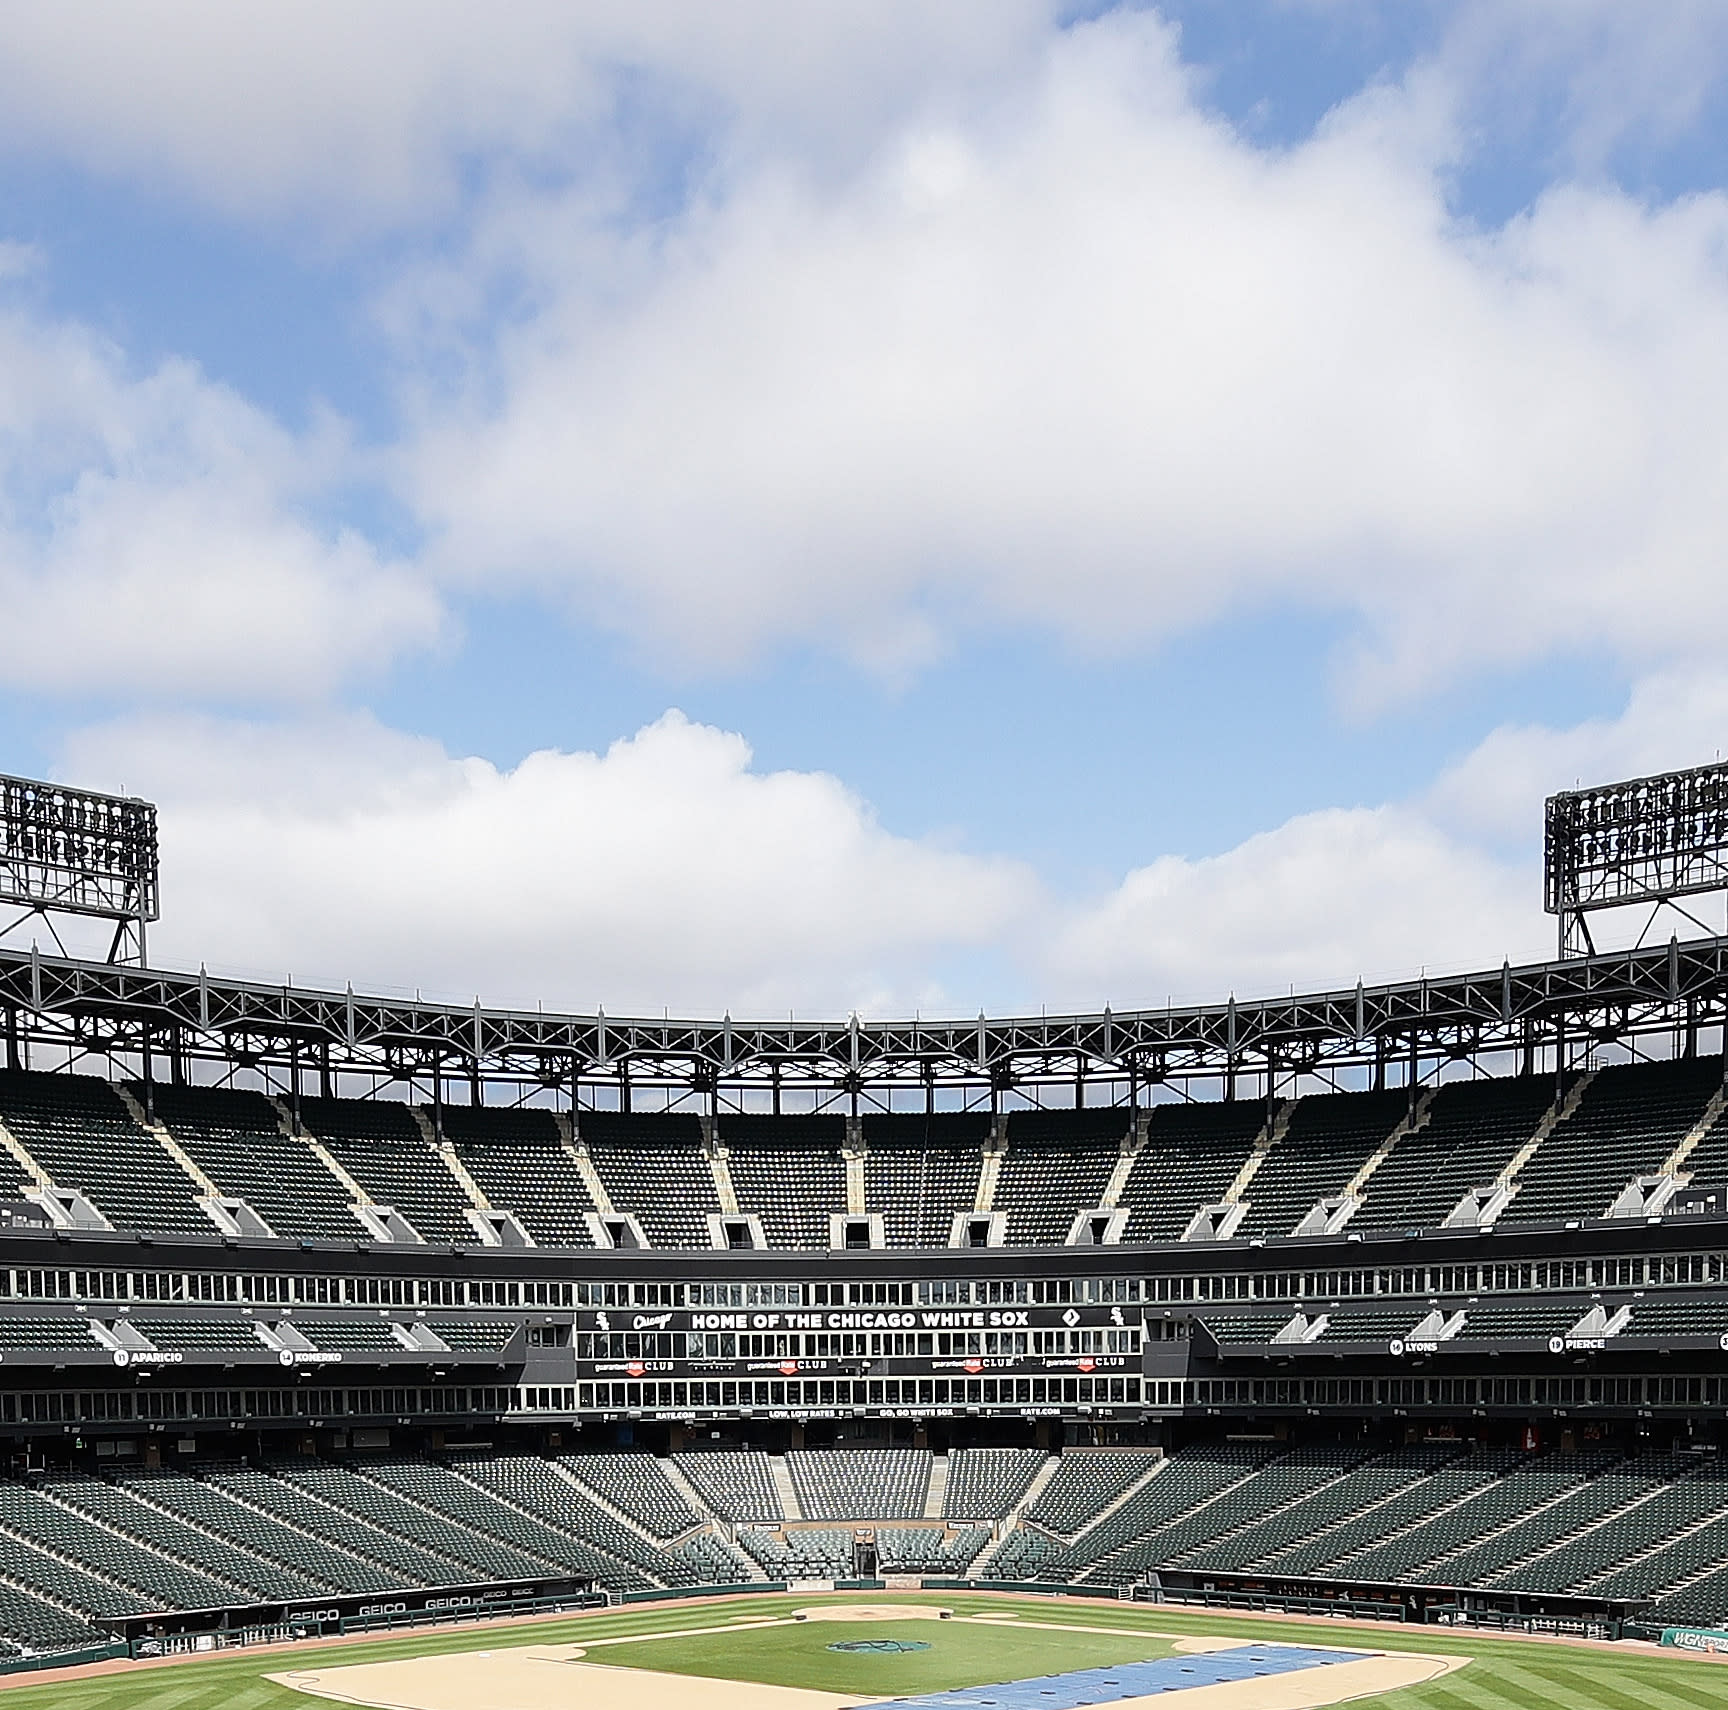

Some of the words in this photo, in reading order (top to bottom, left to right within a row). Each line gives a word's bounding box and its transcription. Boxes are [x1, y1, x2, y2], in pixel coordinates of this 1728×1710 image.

[633, 1313, 673, 1330] Chicago
[692, 1314, 748, 1329] HOME
[753, 1314, 780, 1329] OF
[785, 1313, 822, 1328] THE
[828, 1313, 916, 1328] CHICAGO
[921, 1312, 985, 1327] WHITE
[990, 1311, 1028, 1327] SOX
[1405, 1342, 1438, 1352] LYONS
[1565, 1338, 1606, 1349] PIERCE
[131, 1352, 183, 1363] APARICIO
[1095, 1357, 1125, 1366] CLUB
[644, 1361, 674, 1371] CLUB
[797, 1360, 827, 1369] CLUB
[655, 1411, 696, 1420] RATE.COM
[790, 1410, 809, 1418] LOW
[809, 1410, 835, 1418] RATES
[896, 1409, 909, 1417] GO
[937, 1408, 954, 1416] SOX
[1020, 1407, 1061, 1415] RATE.COM
[425, 1596, 471, 1610] GEICO
[359, 1602, 406, 1616] GEICO
[289, 1609, 340, 1623] GEICO
[1674, 1632, 1706, 1648] WGN
